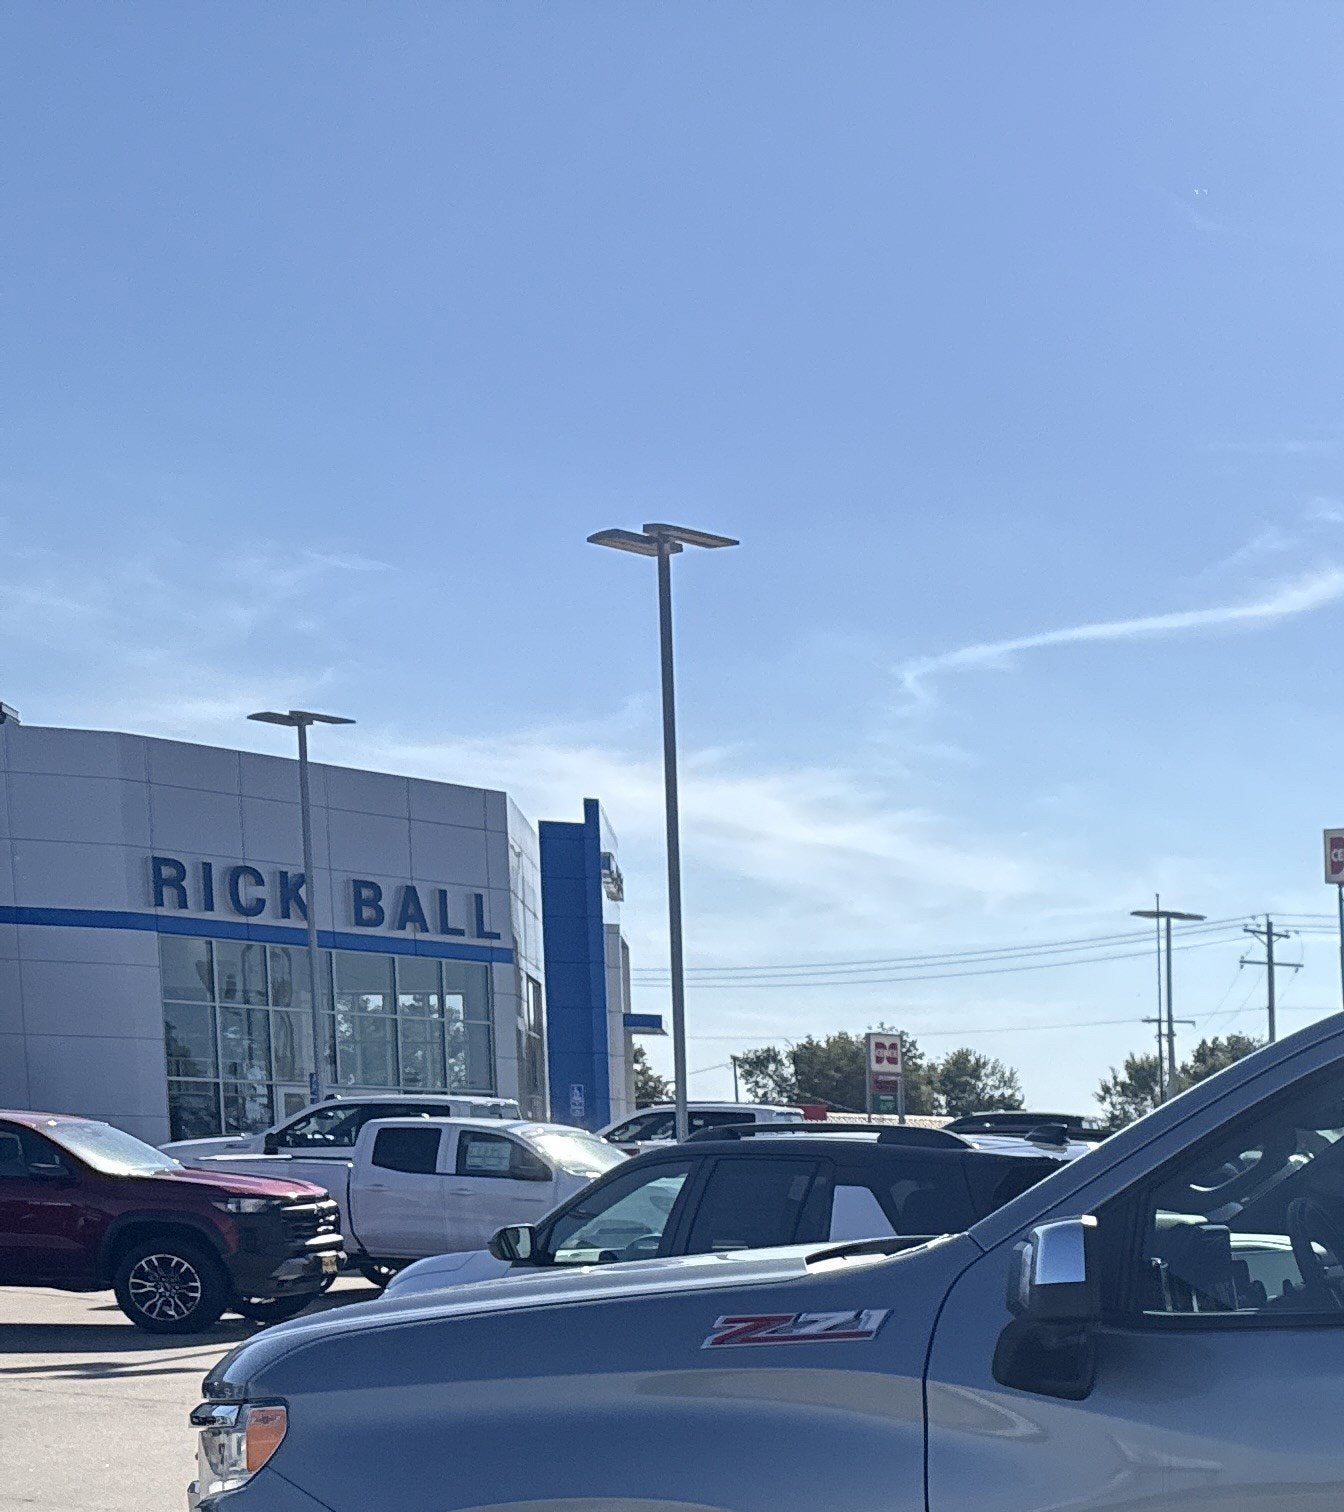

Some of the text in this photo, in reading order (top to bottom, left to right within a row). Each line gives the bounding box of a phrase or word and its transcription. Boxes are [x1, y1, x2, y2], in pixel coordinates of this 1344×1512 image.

[151, 855, 502, 941] RICK BALL
[701, 1308, 890, 1350] Z71
